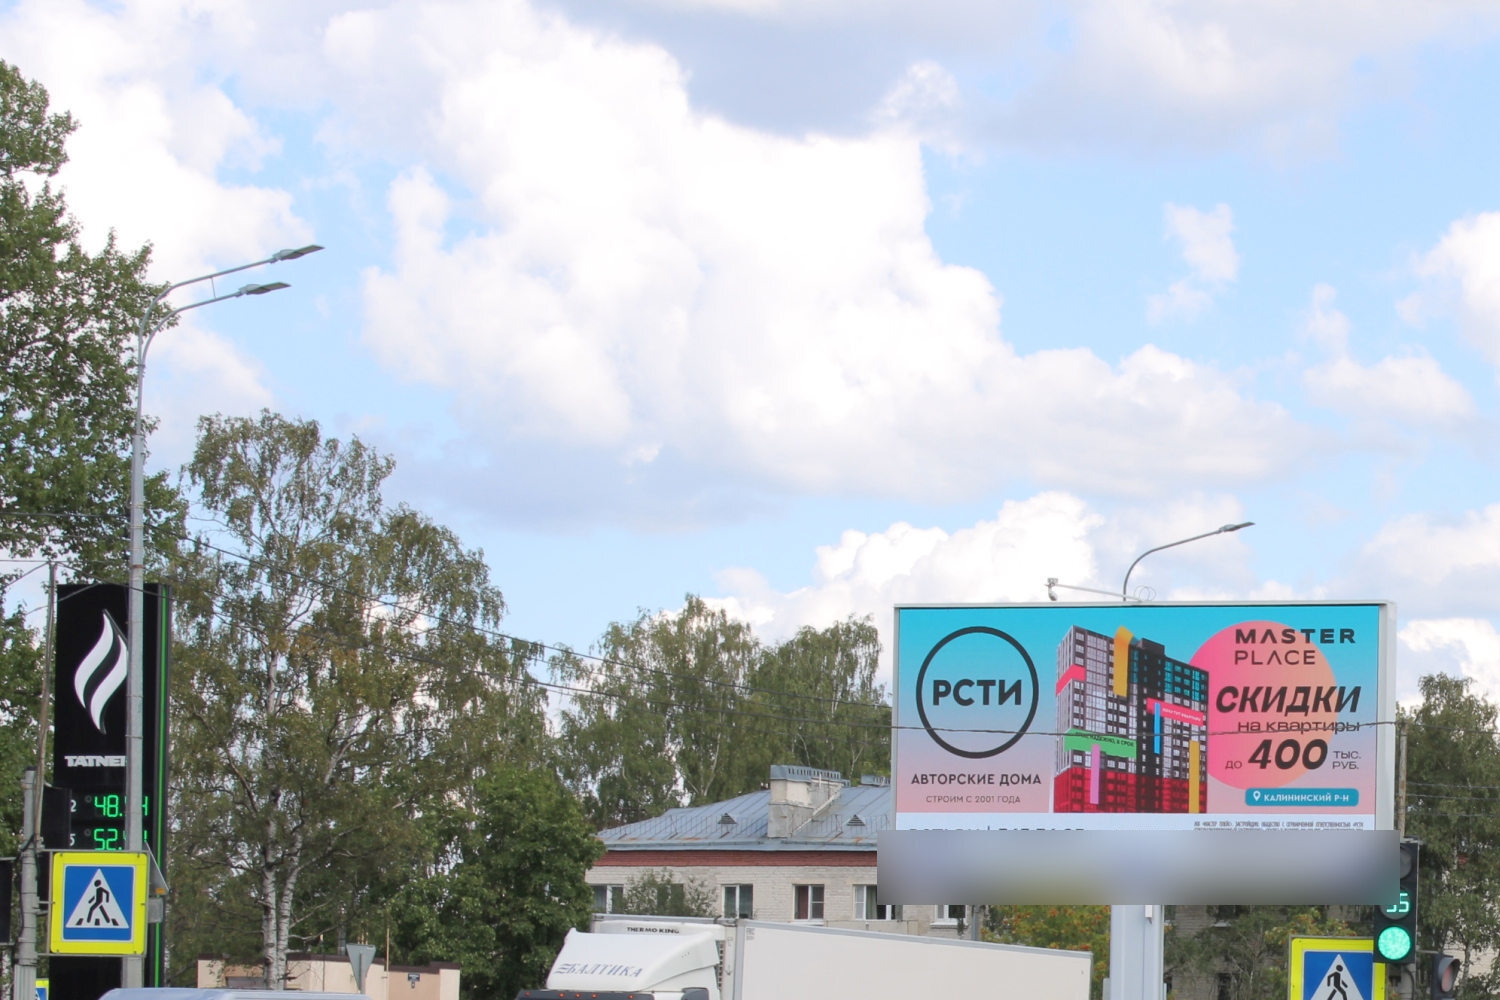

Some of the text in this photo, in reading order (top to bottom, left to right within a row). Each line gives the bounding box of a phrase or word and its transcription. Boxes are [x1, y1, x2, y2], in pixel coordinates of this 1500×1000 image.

[1235, 628, 1356, 644] MASTER
[1234, 650, 1316, 666] PLACE
[932, 678, 1022, 706] РСТИ
[1215, 685, 1362, 717] СКИДКИ
[1237, 721, 1361, 735] на квартиры
[1248, 738, 1329, 770] 400
[1333, 750, 1361, 760] ТЫС.
[1332, 761, 1360, 770] РУБ.
[911, 773, 1042, 787] АВТОРСКИЕ ДОМА
[925, 795, 1021, 804] СТРОИМ С 2001 ГОДА
[1263, 792, 1350, 803] КАЛИНИНСКИЙ Р-Н
[626, 926, 680, 935] THERMO KING
[555, 963, 644, 978] БАЛТИКА
